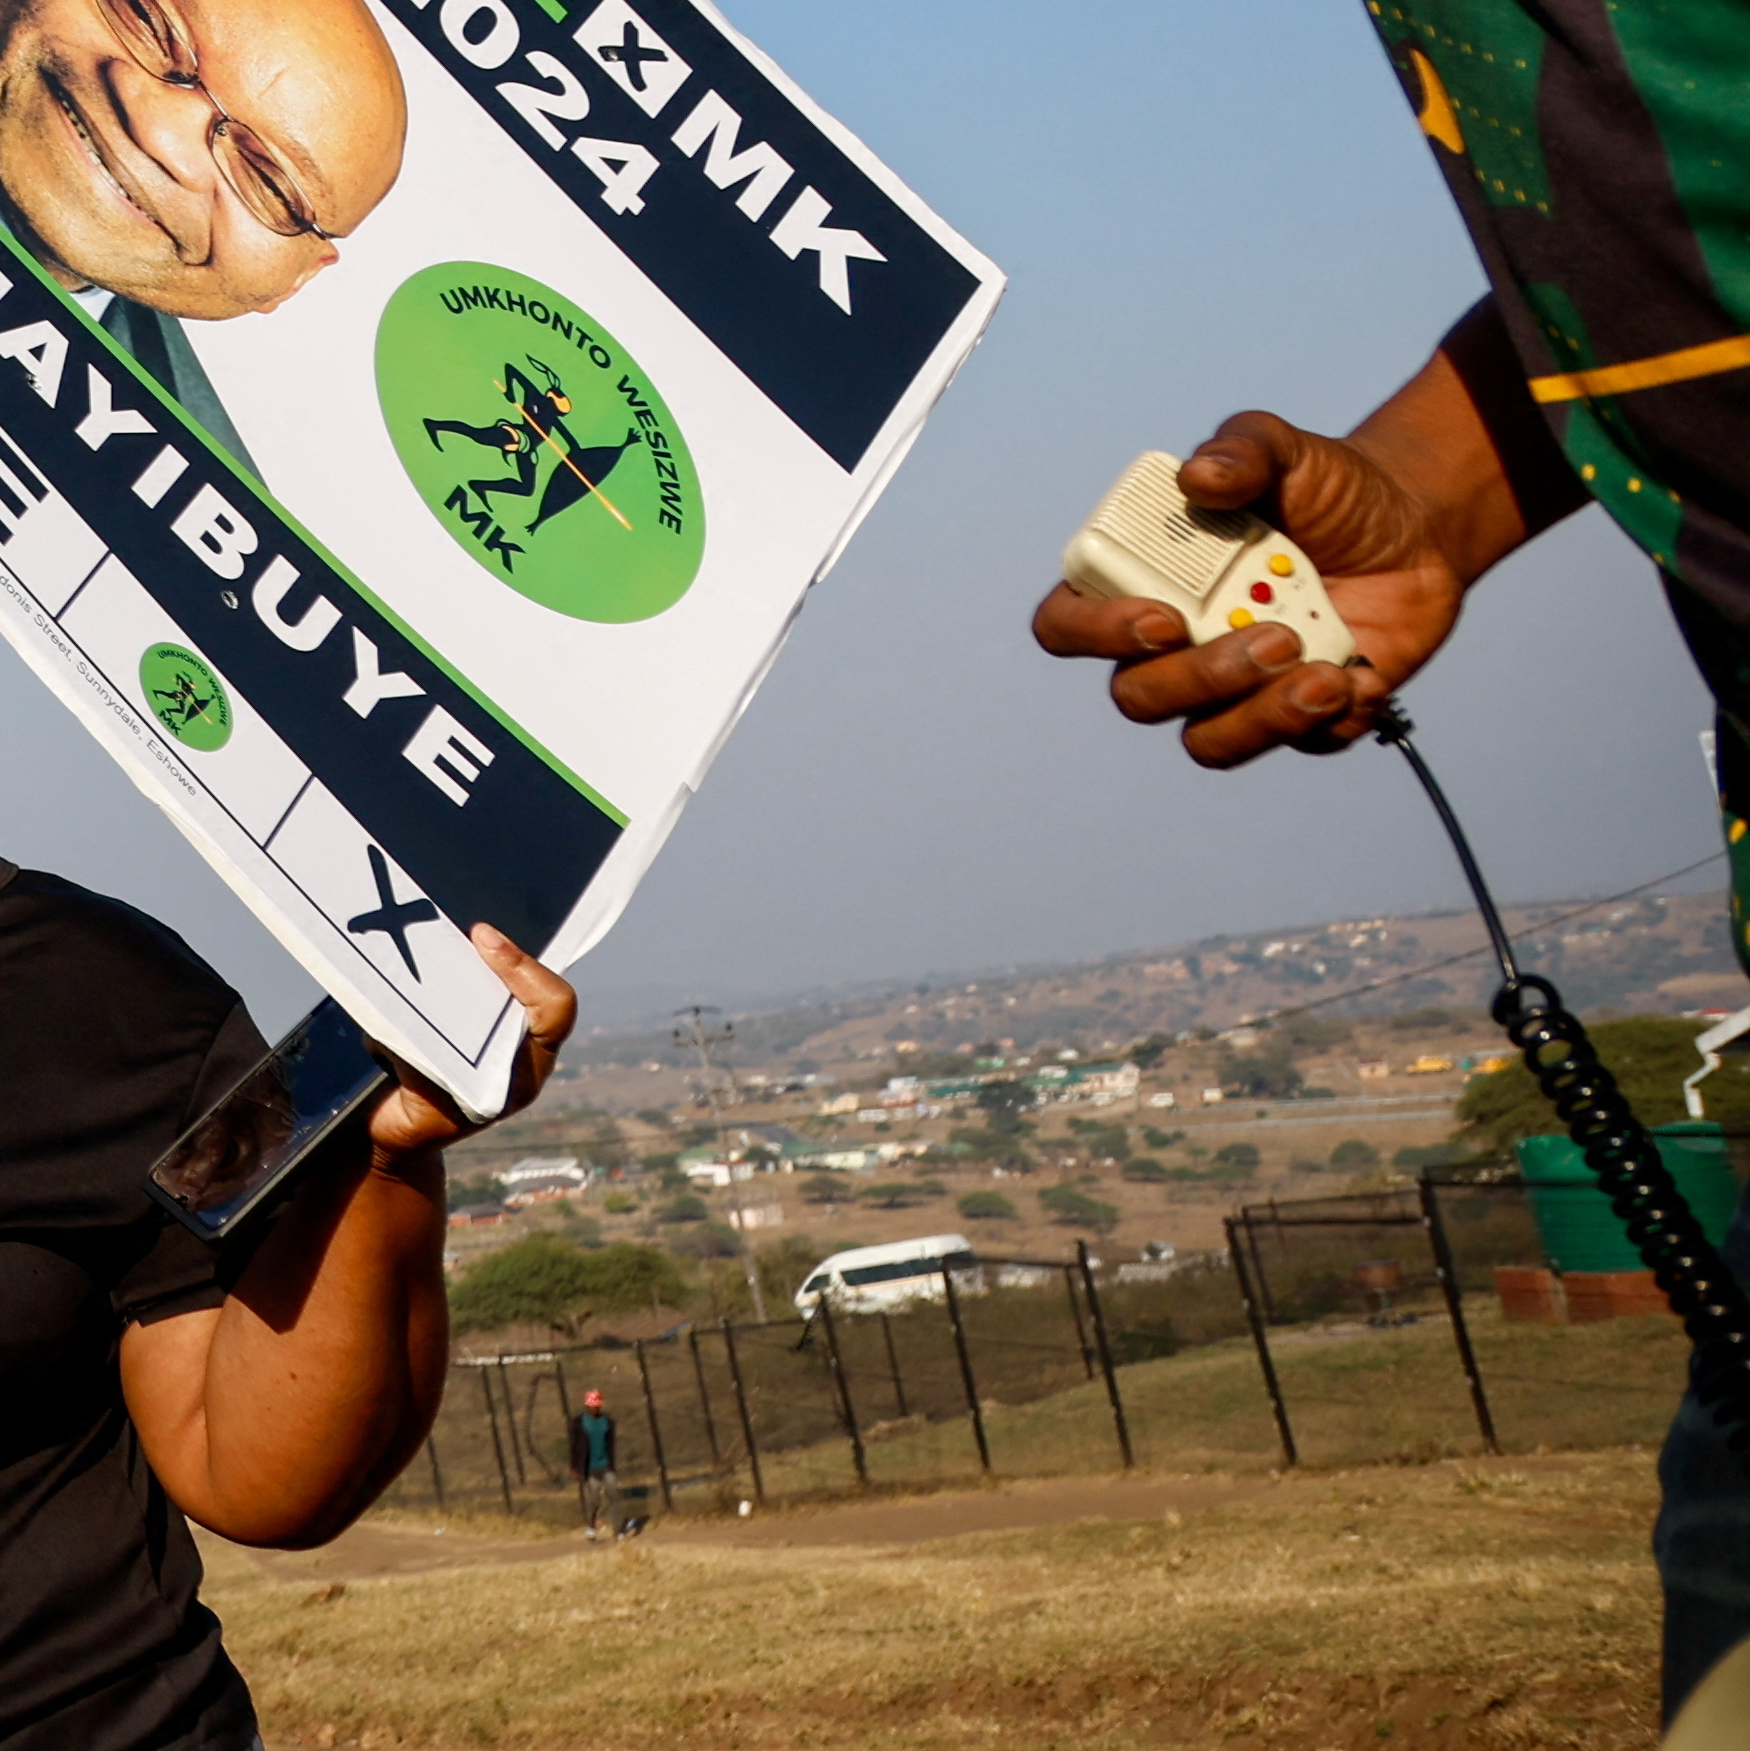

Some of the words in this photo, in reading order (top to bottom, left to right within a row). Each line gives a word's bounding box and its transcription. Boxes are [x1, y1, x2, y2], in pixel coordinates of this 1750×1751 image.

[670, 88, 889, 316] MK
[439, 286, 611, 369] UMKHONTO
[617, 374, 684, 535] WESIZWE
[443, 484, 526, 575] MK
[33, 614, 73, 663] Street,
[76, 661, 143, 741] Sunnydale,
[146, 738, 197, 796] Eshowe
[159, 710, 182, 736] MK
